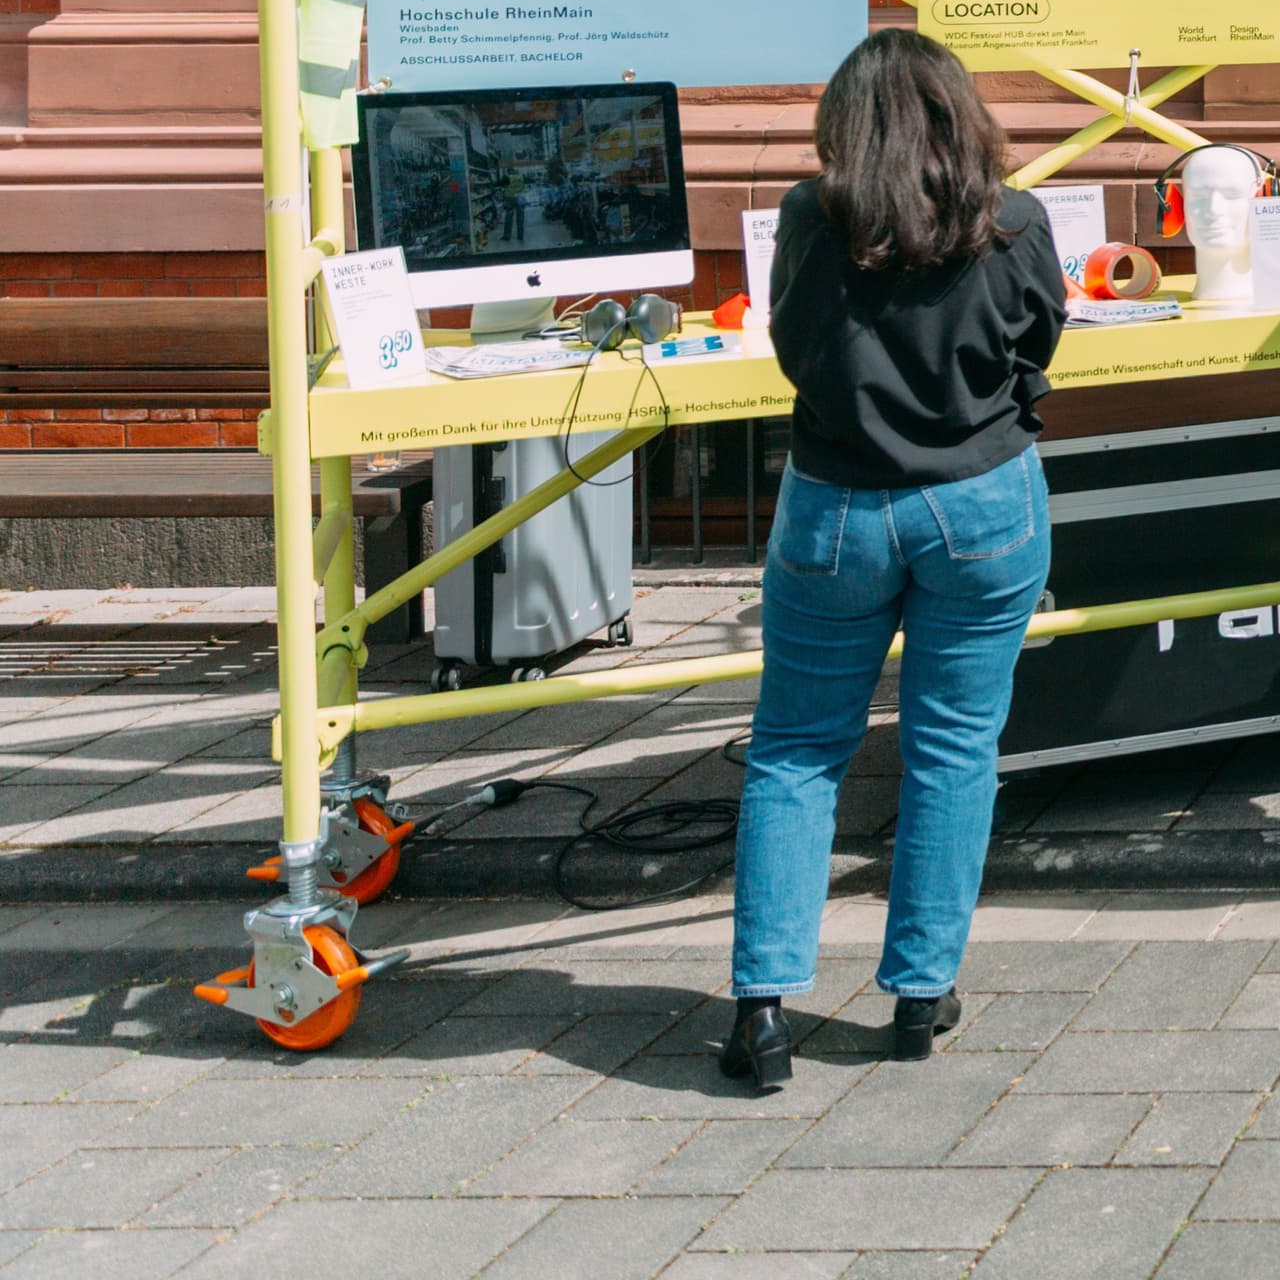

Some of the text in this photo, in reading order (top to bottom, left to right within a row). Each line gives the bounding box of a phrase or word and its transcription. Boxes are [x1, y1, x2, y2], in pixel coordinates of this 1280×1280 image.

[400, 6, 593, 21] Hochschule RheinMain
[944, 2, 1038, 18] LOCATION
[399, 23, 459, 33] Wiesbaden
[1178, 26, 1204, 34] World
[1229, 24, 1262, 35] Design
[1178, 34, 1217, 43] Frankfurt
[1230, 32, 1275, 41] RheinMain
[399, 52, 583, 65] ABSCHLUSSARBEIT, BACHELOR
[331, 258, 394, 278] INNER-WORK
[335, 277, 367, 289] WESTE
[1113, 359, 1184, 374] Wissenschaft
[1186, 357, 1205, 367] und
[1208, 355, 1241, 365] Kunst,
[361, 431, 383, 442] Mit
[387, 427, 439, 442] großem
[442, 423, 477, 435] Dank
[480, 422, 498, 432] für
[502, 419, 527, 430] ihre
[530, 411, 624, 427] Unterstützung:
[628, 405, 671, 418] HSRM
[685, 397, 757, 413] Hochschule
